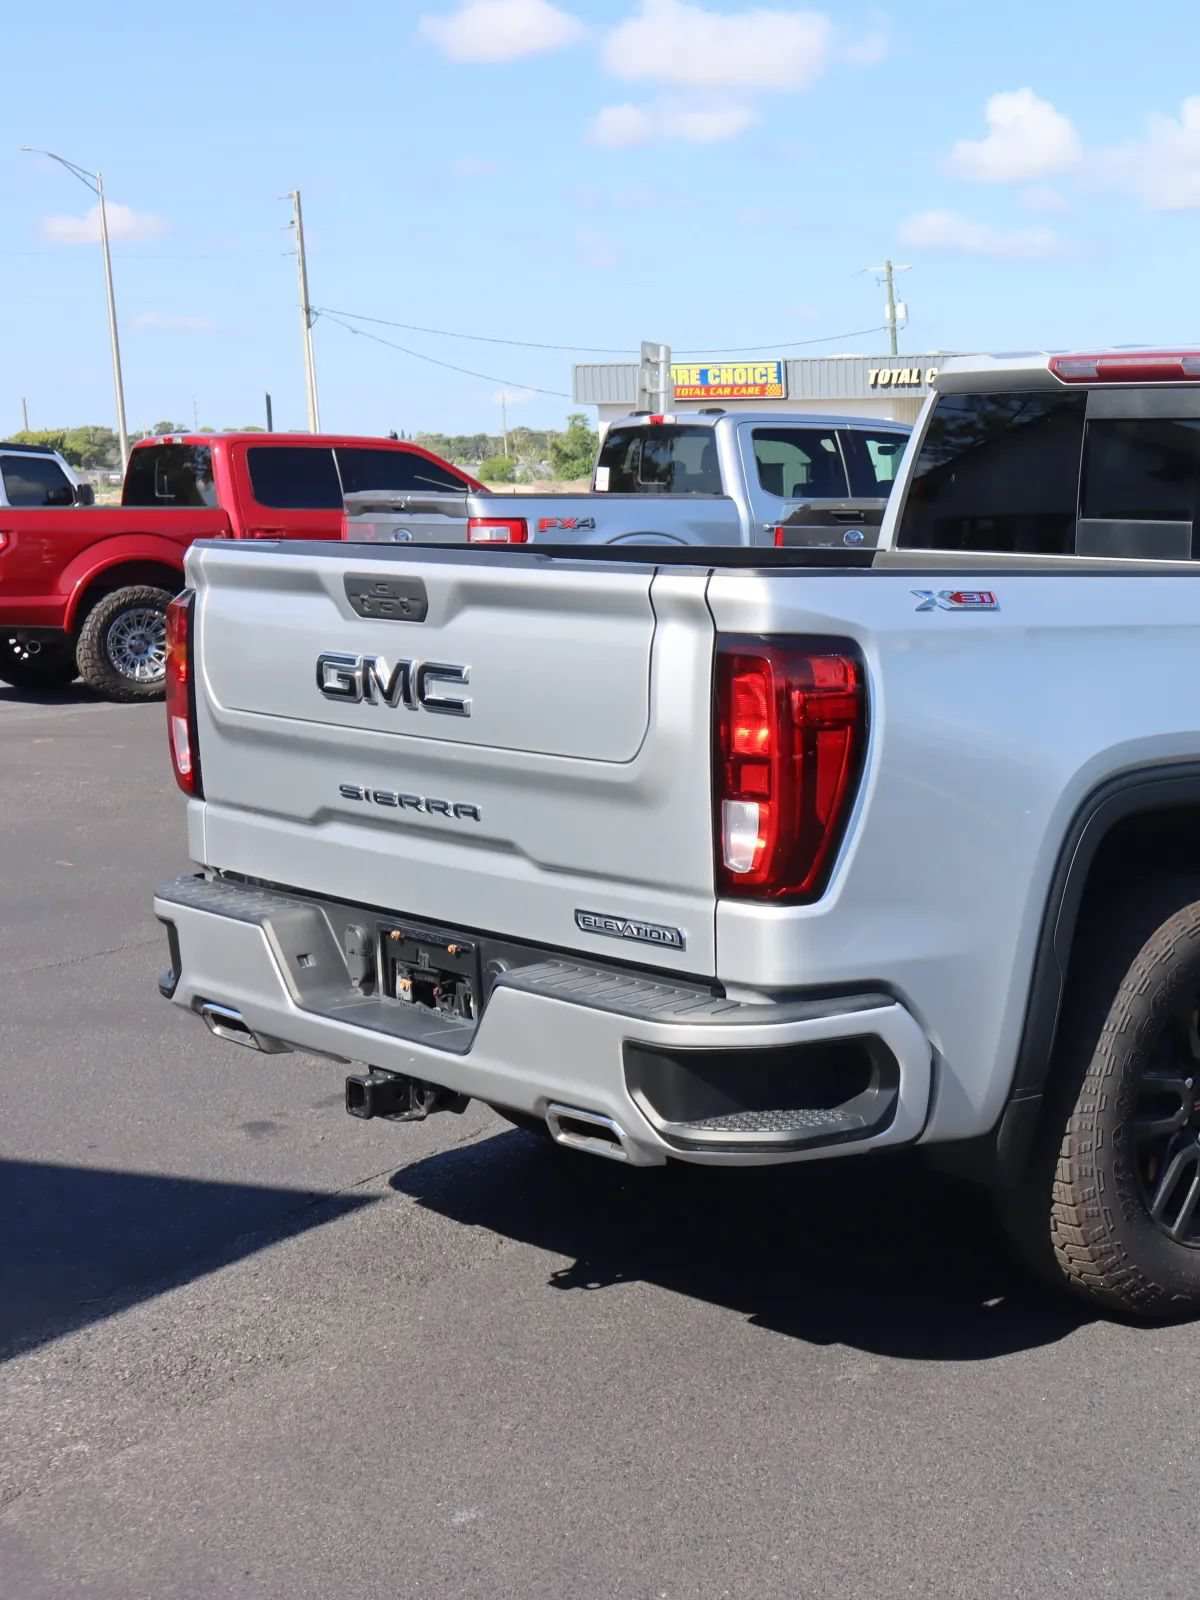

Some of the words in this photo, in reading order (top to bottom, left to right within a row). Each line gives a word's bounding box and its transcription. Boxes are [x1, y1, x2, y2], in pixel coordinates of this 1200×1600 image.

[670, 369, 701, 385] IRE
[707, 367, 778, 384] CHOICE
[867, 367, 920, 384] TOTAL
[675, 387, 706, 396] TOTAL
[709, 386, 733, 396] CAR
[736, 386, 762, 395] CARE
[538, 517, 596, 532] FX4
[316, 651, 473, 718] GMC
[338, 783, 482, 822] SIERRA
[582, 916, 676, 942] ELEVATION
